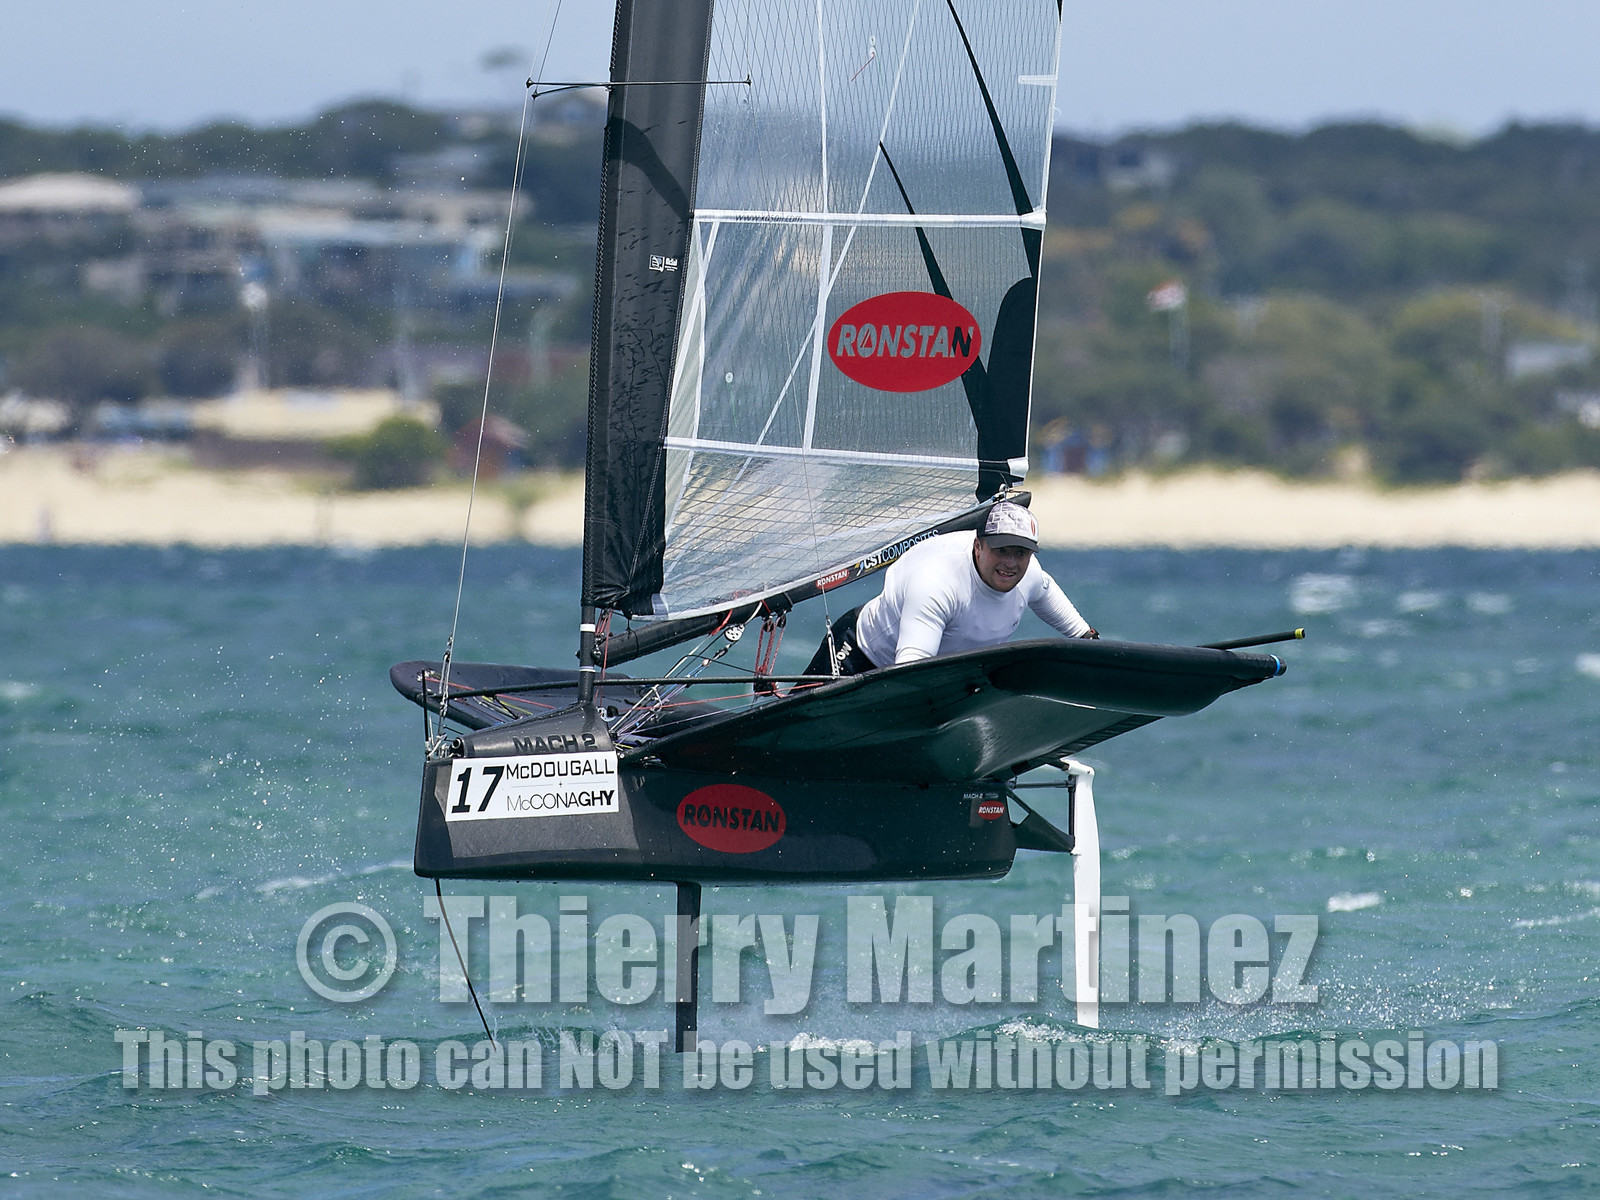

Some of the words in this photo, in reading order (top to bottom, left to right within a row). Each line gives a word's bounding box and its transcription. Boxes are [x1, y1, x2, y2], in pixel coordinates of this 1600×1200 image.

[836, 323, 974, 358] RONSTAN
[817, 569, 848, 587] RONSTAN
[513, 734, 578, 753] MACH
[582, 733, 598, 750] 2
[507, 759, 615, 780] McDOUGALL
[451, 766, 505, 813] 17
[507, 790, 615, 811] McCONAGHY
[978, 806, 1004, 814] RONSTAN
[683, 804, 780, 833] RONSTAN
